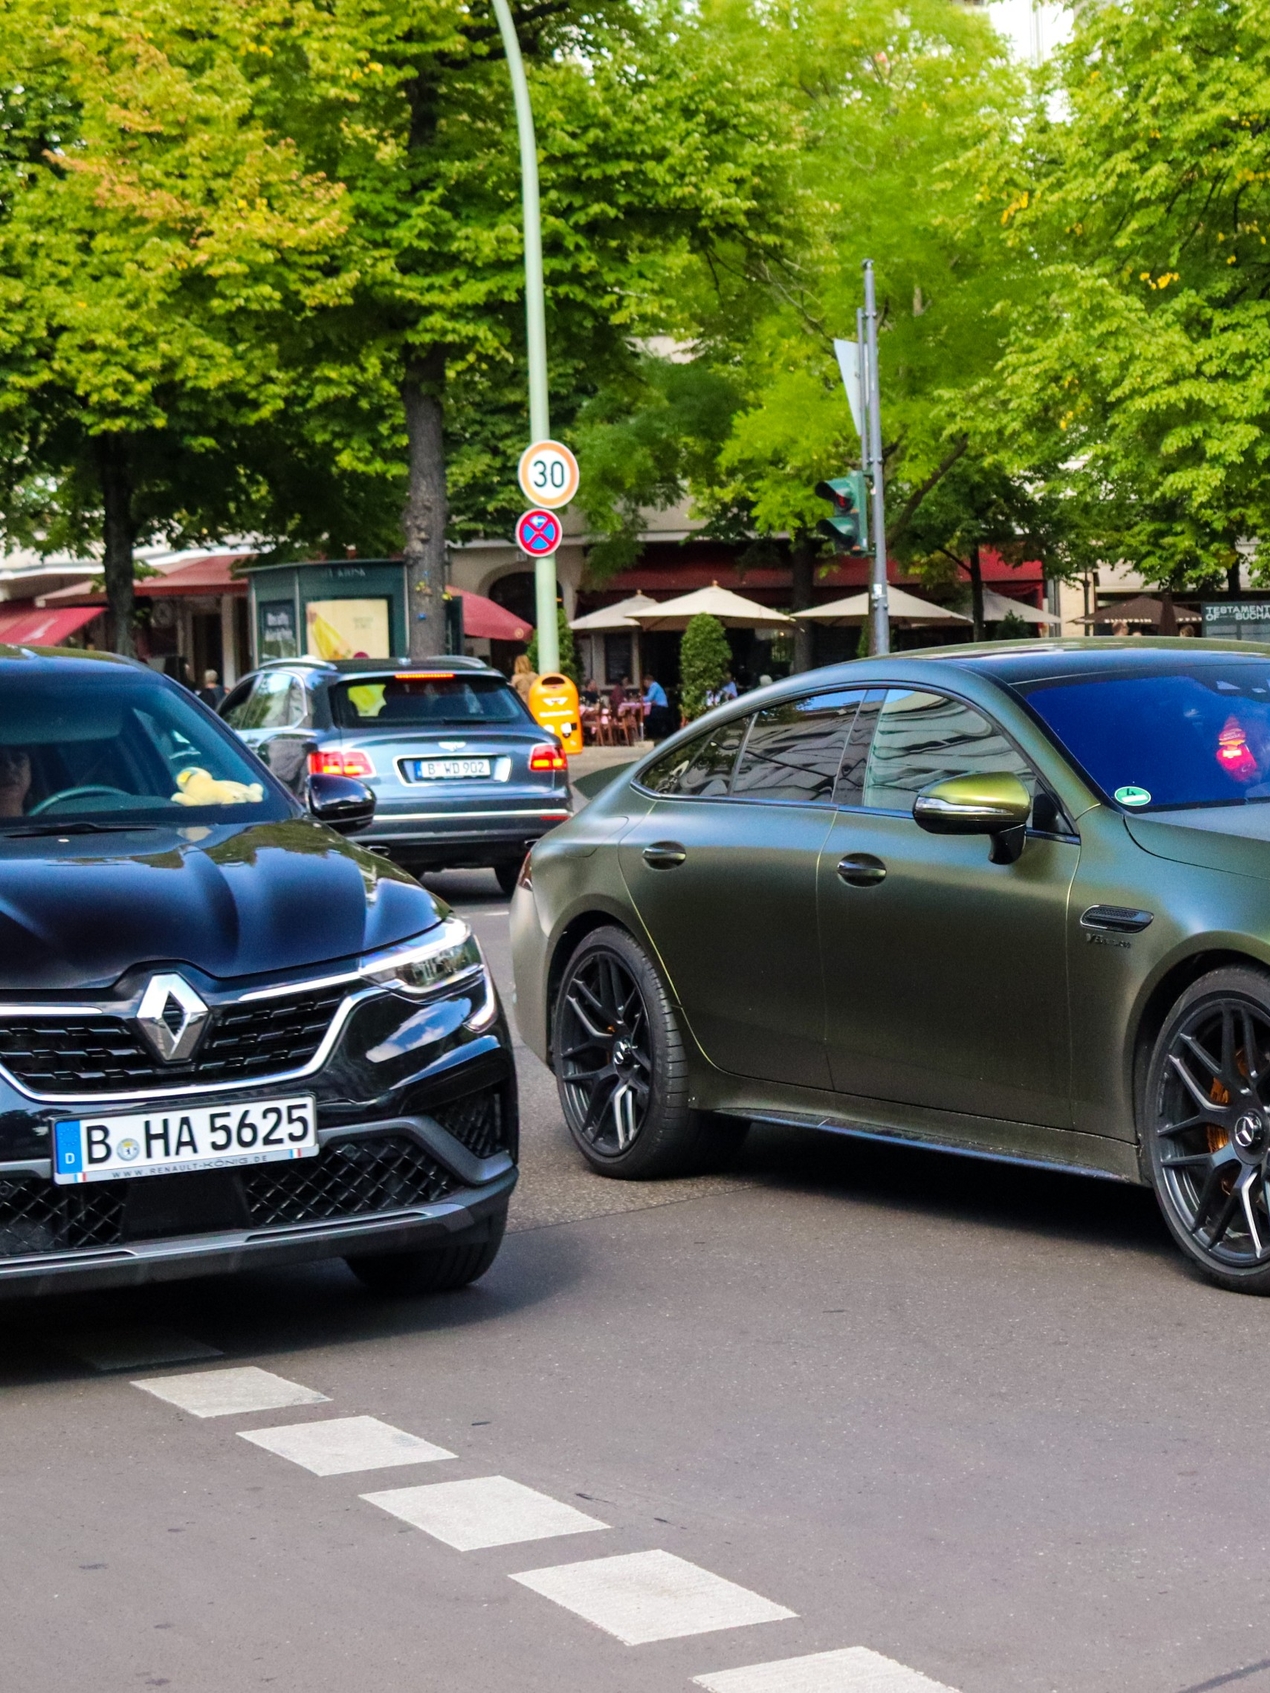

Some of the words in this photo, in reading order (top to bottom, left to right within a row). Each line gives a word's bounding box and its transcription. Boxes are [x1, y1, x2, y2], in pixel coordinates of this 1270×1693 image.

[533, 460, 564, 488] 30
[1206, 605, 1270, 614] TESTAMENT
[1206, 613, 1220, 621] OF
[1235, 612, 1270, 620] BUCHA
[428, 763, 435, 775] B
[462, 762, 484, 773] 902
[65, 1152, 76, 1164] D
[86, 1124, 112, 1165] B
[144, 1116, 198, 1159] HA
[209, 1103, 309, 1151] 5625
